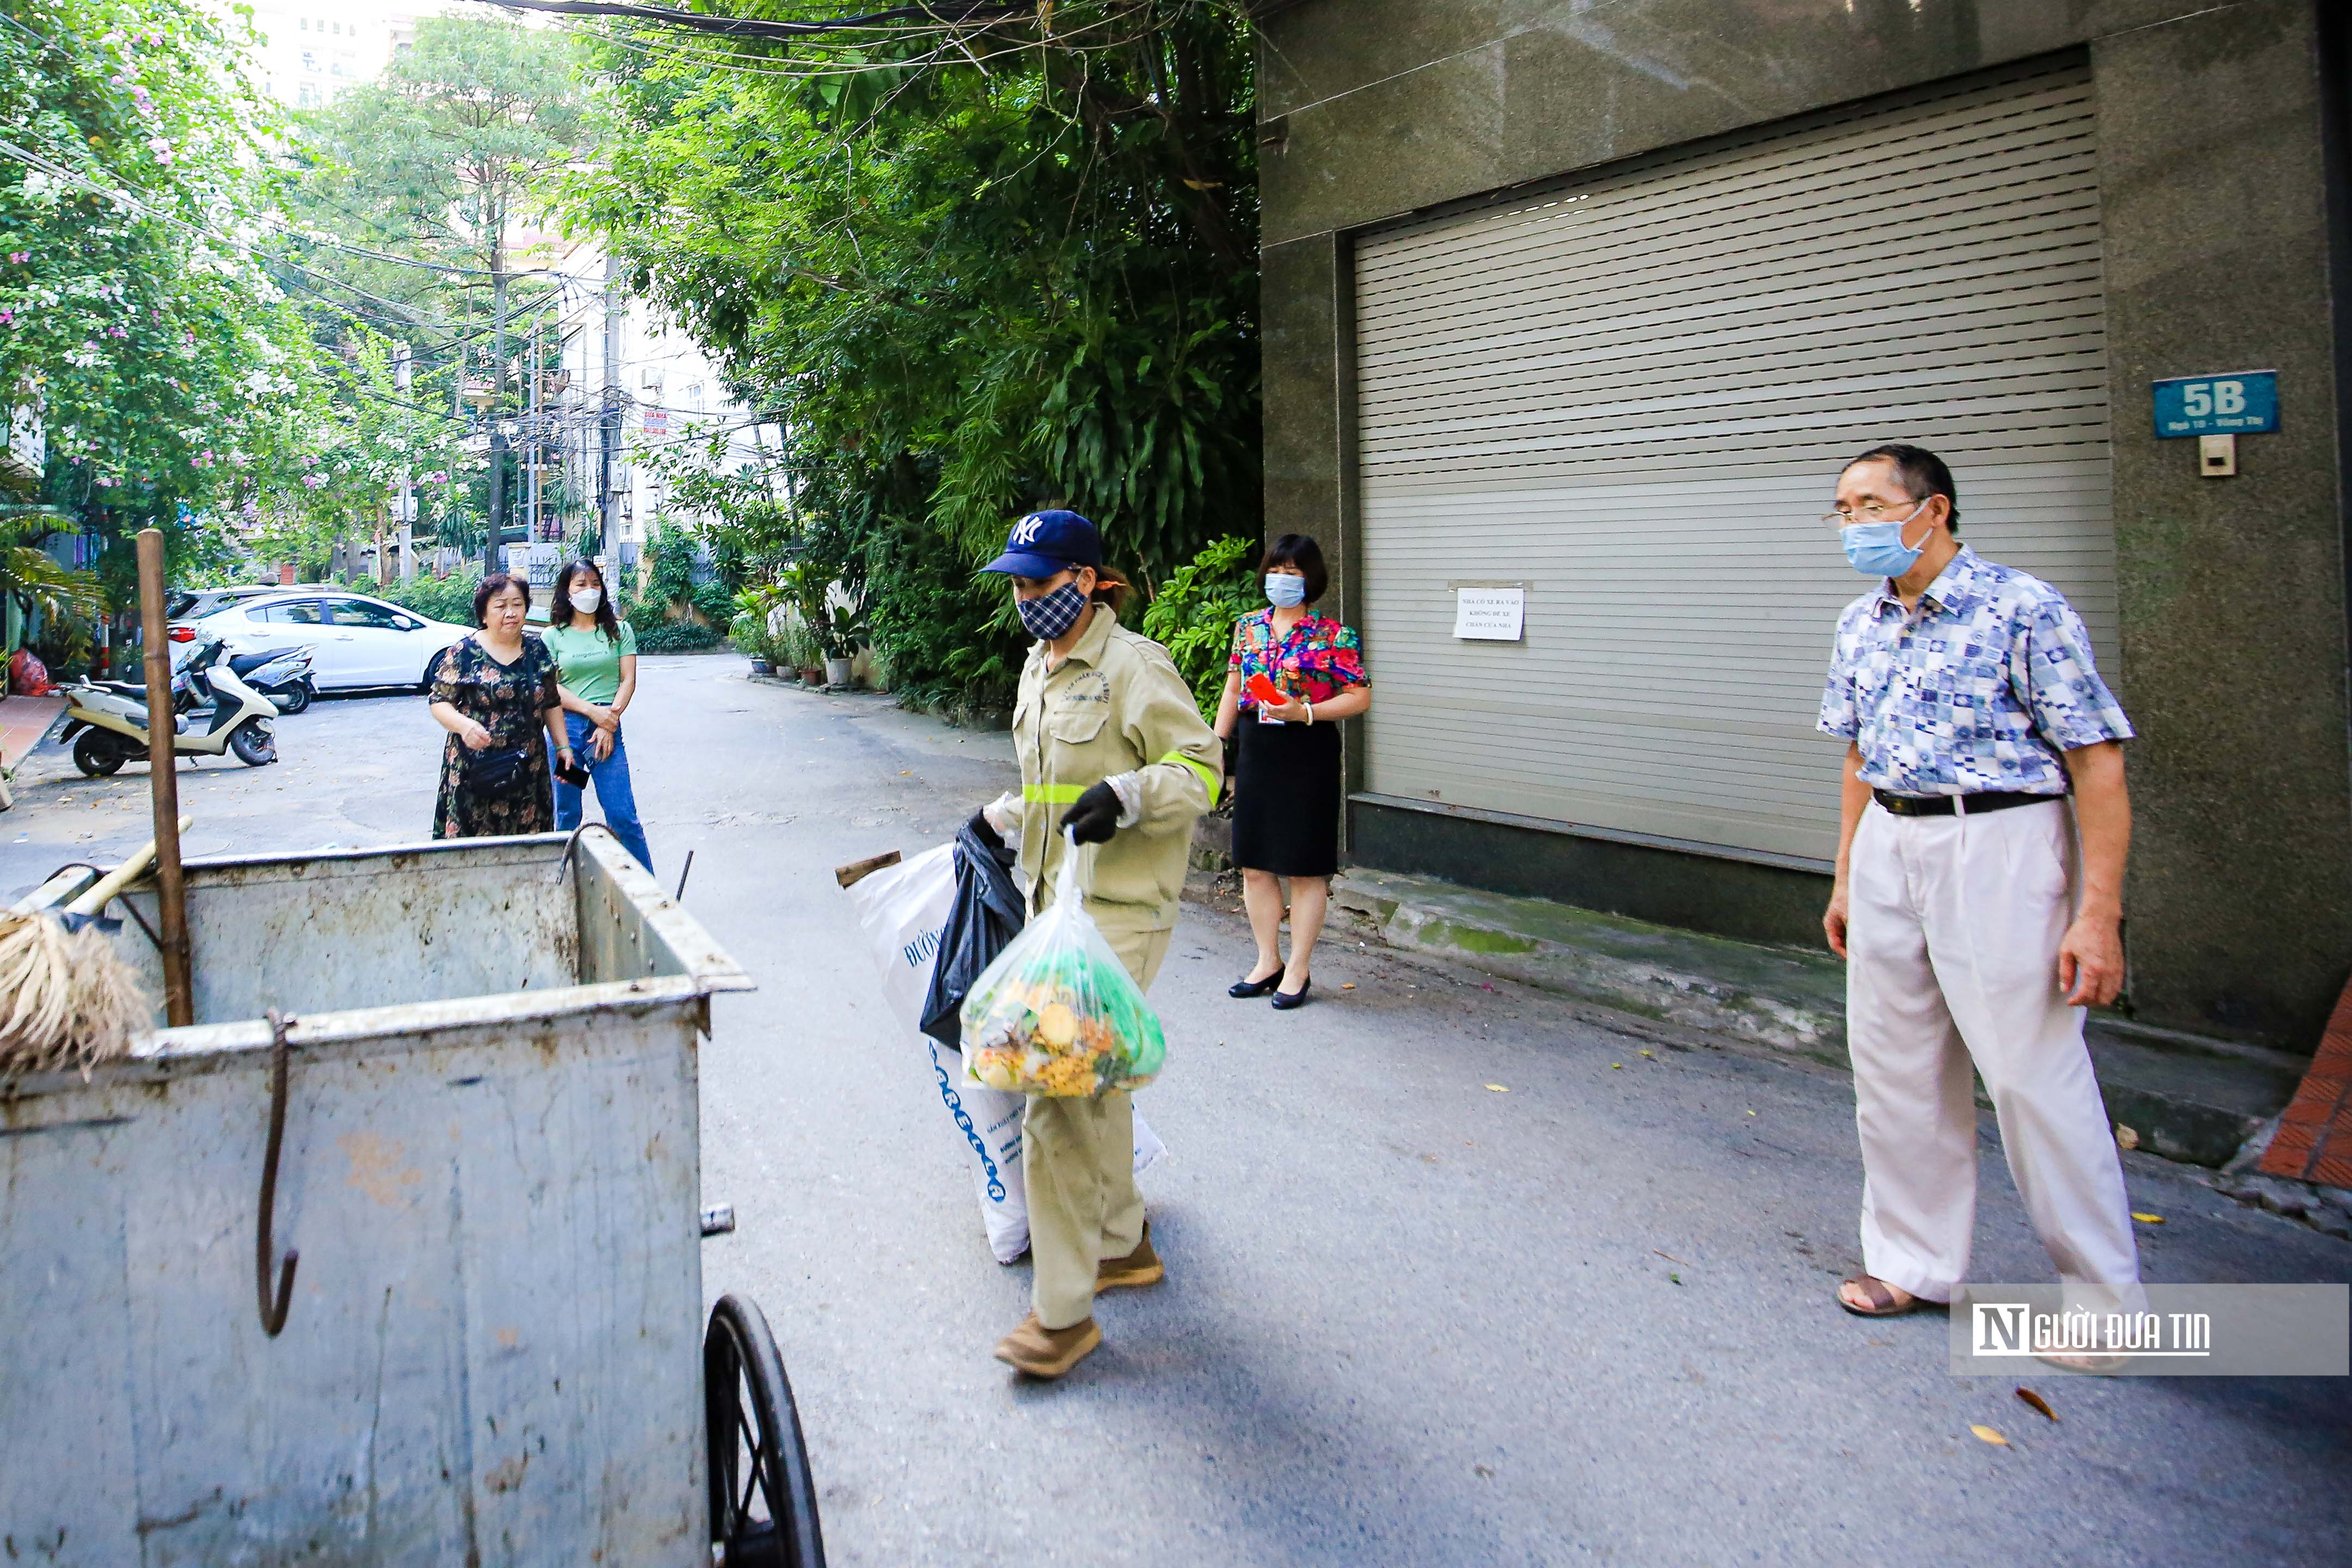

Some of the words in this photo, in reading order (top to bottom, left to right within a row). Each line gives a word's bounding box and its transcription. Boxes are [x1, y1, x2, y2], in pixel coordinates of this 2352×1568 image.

[2184, 380, 2246, 416] 5B
[1013, 515, 1043, 545] NY
[904, 928, 945, 968] ĐƯỜN
